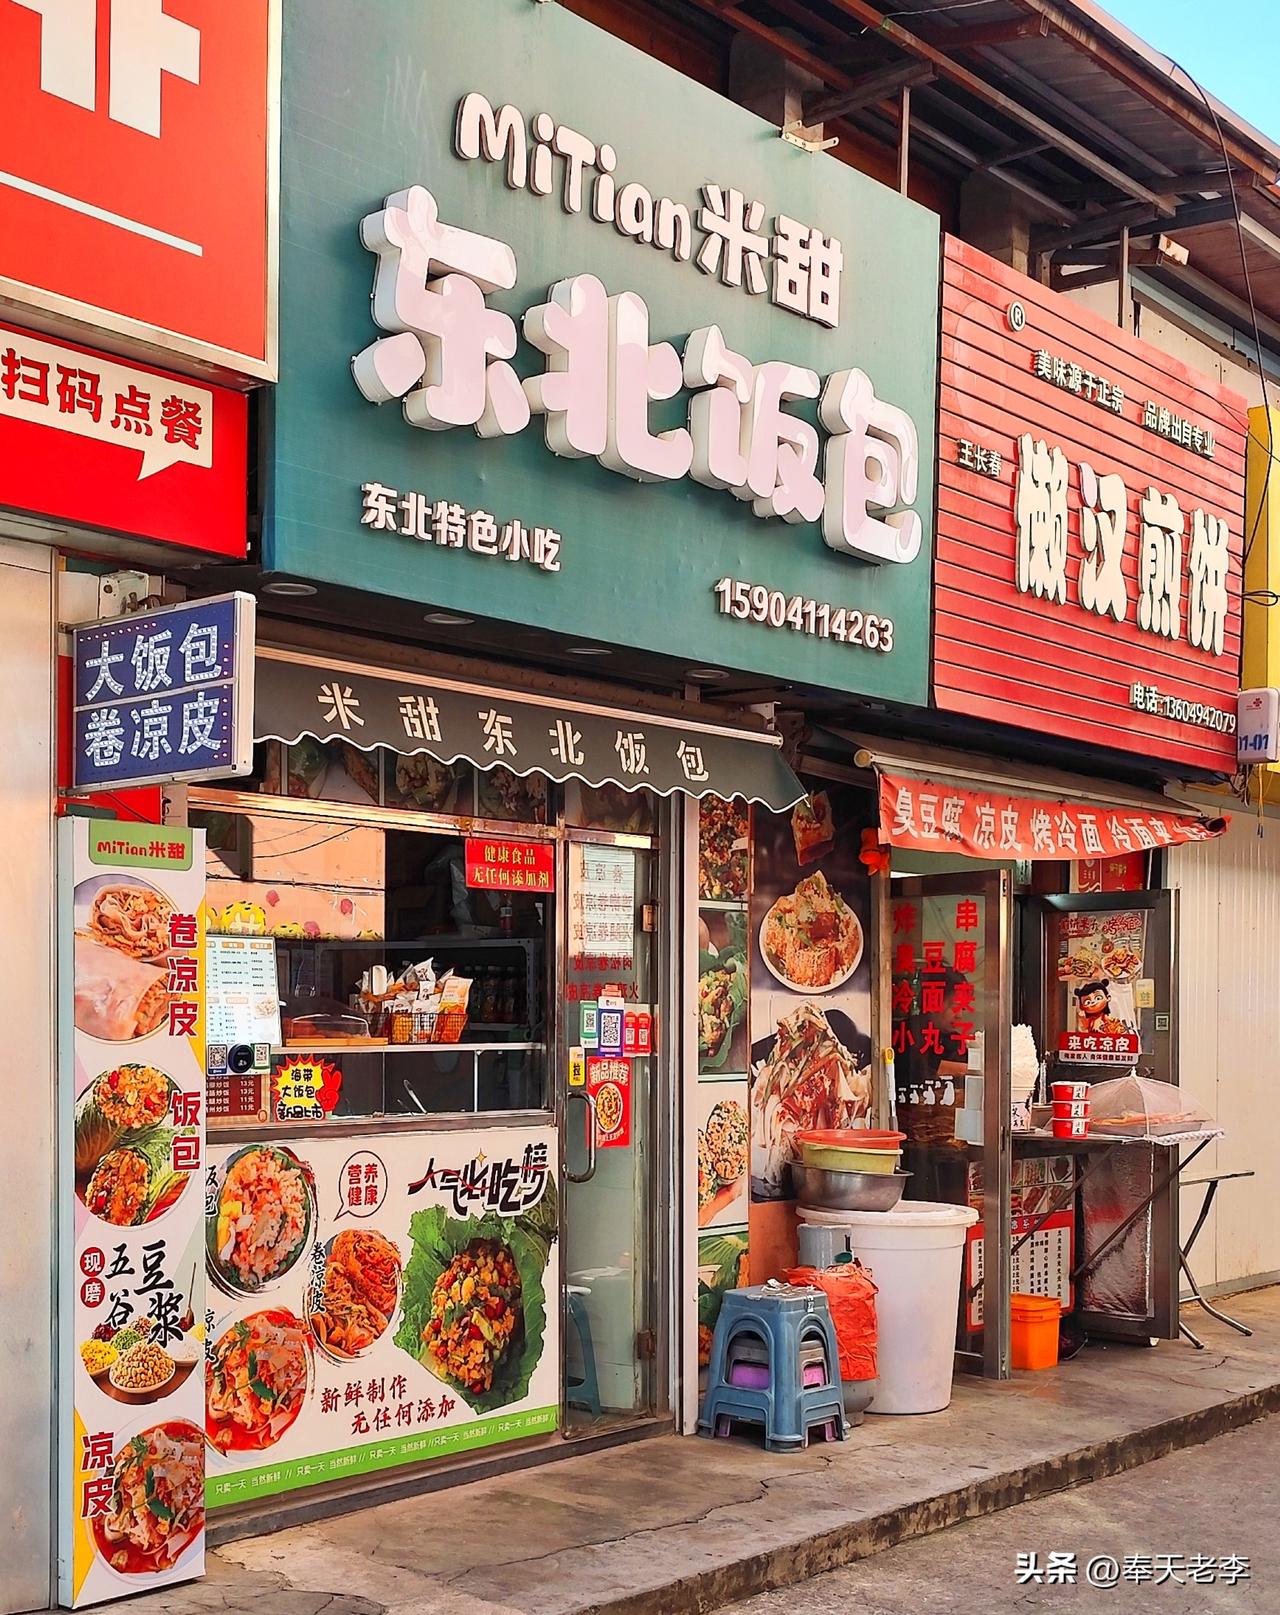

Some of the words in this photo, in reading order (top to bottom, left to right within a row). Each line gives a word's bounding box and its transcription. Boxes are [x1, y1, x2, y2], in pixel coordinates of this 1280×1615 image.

[1, 348, 202, 450] 扫码点餐
[351, 184, 922, 565] 东北饭包
[1034, 349, 1125, 414] 美味源于正宗
[1143, 401, 1216, 459] 品牌出自专业
[958, 438, 1002, 477] 王长春
[361, 482, 561, 572] 东北特色小吃
[1014, 432, 1230, 657] 懒汉煎饼
[714, 577, 895, 653] 15904114263
[85, 622, 222, 701] 大饭包
[85, 691, 222, 767] 卷凉皮
[317, 682, 709, 783] 米甜东北饭包
[484, 845, 536, 865] 健康食品
[892, 787, 966, 842] 臭豆腐
[973, 804, 1022, 851] 凉皮
[1030, 808, 1105, 855] 烤冷面
[473, 866, 550, 889] 无任何添加剂
[167, 913, 198, 1037] 卷凉皮
[591, 1060, 630, 1085] 新品推荐
[893, 1021, 976, 1055] 小丸子
[277, 1102, 323, 1119] 新品上市
[281, 1085, 315, 1098] 大饭包
[291, 1068, 313, 1082] 海带
[170, 1090, 201, 1170] 饭包
[348, 1163, 378, 1185] 营养
[348, 1186, 378, 1207] 健康
[408, 1143, 549, 1217] 人气必吃榜
[83, 1252, 102, 1303] 现磨
[105, 1243, 135, 1328] 五谷
[134, 1240, 184, 1348] 豆浆
[310, 1242, 326, 1314] 卷凉皮
[320, 1375, 408, 1413] 新鲜制作
[351, 1394, 456, 1435] 无任何添加
[82, 1432, 114, 1517] 凉皮
